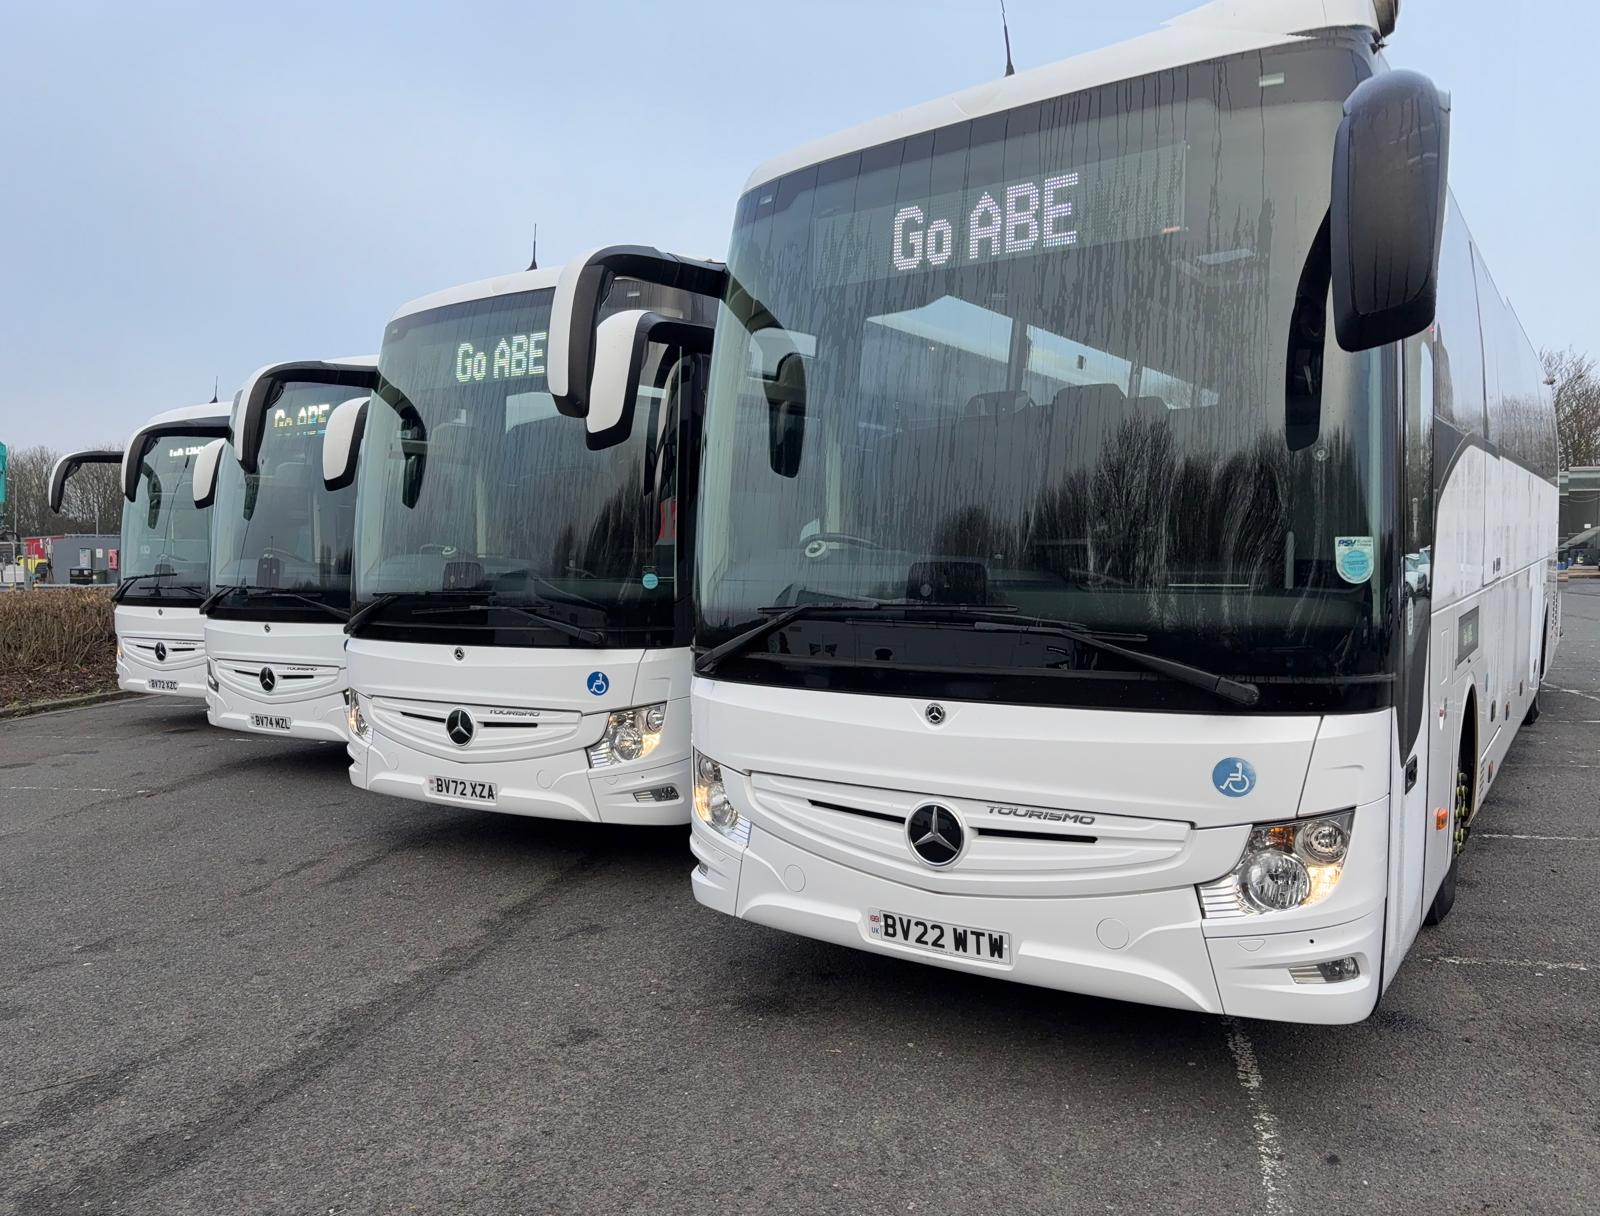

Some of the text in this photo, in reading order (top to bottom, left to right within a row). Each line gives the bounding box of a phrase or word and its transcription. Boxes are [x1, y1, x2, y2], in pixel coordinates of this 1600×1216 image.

[893, 172, 1079, 270] Go ABE
[456, 331, 547, 382] Go ABE
[255, 715, 290, 729] BV74 MZL
[436, 777, 495, 800] BV72 XZA
[986, 805, 1096, 825] TOURISMO
[871, 926, 880, 934] UK
[883, 913, 1003, 959] BV22 WTW
